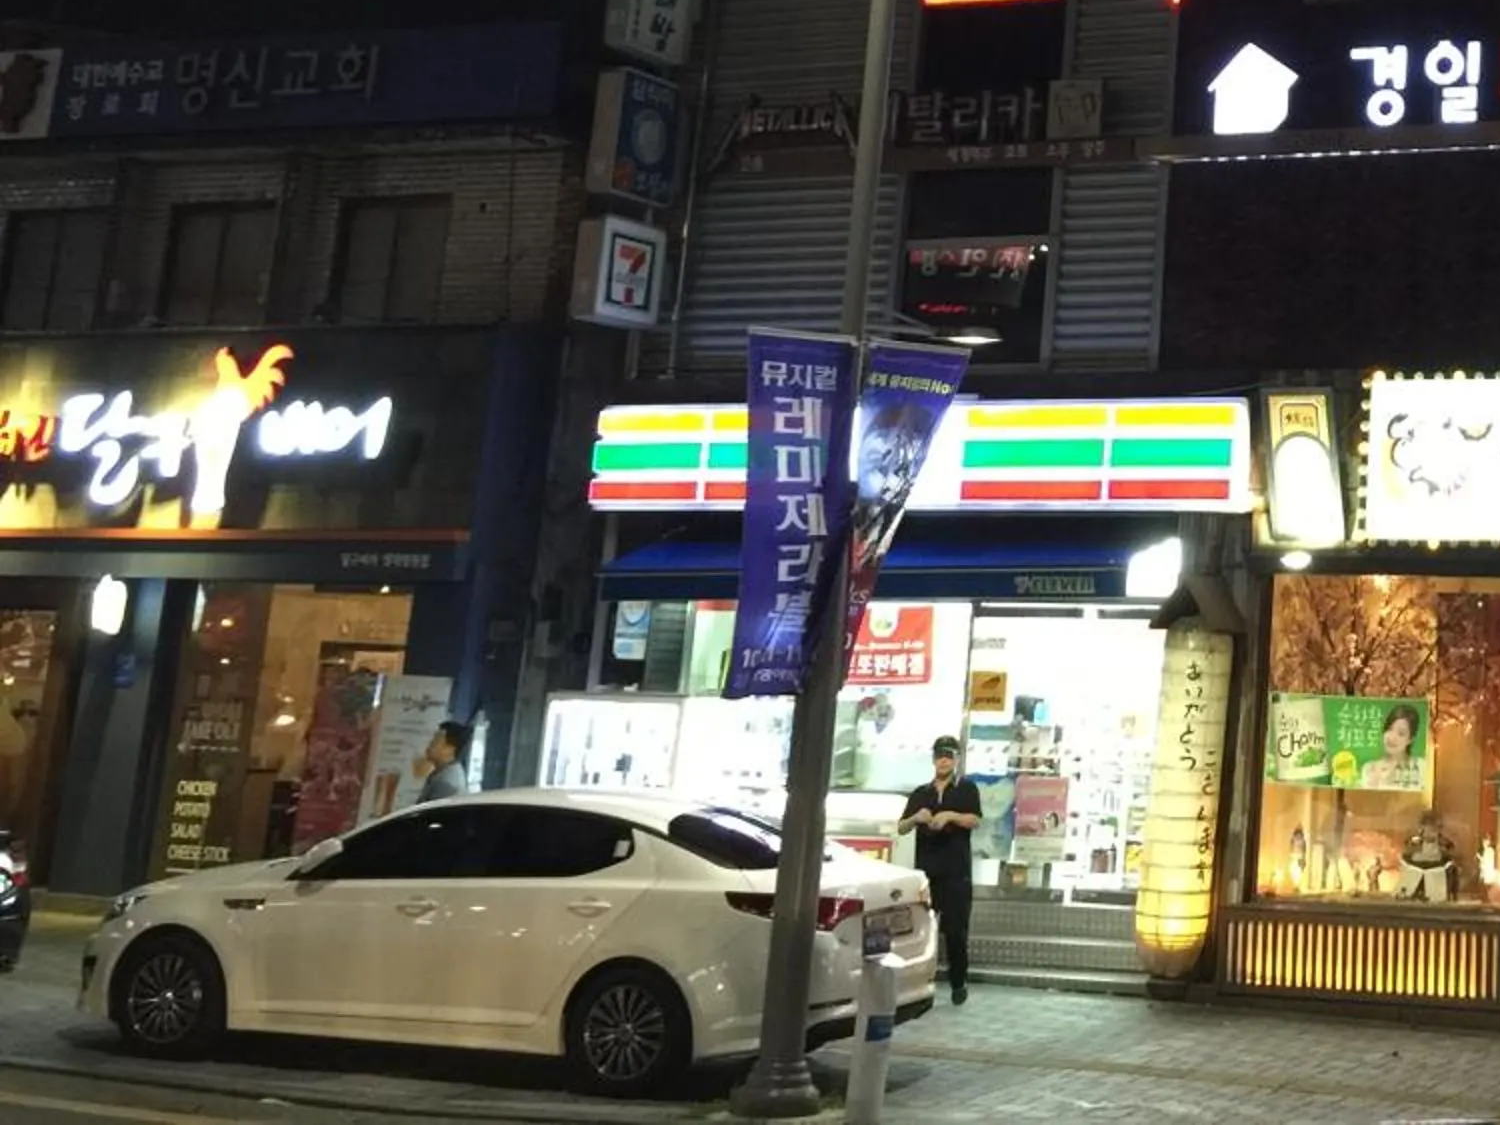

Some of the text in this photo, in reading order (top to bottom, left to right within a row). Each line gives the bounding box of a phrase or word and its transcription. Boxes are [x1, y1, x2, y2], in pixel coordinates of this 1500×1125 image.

[175, 44, 380, 115] 명신교회
[888, 86, 1043, 144] 탈리카
[761, 360, 838, 392] 뮤지컬
[767, 395, 829, 634] 레미제라블
